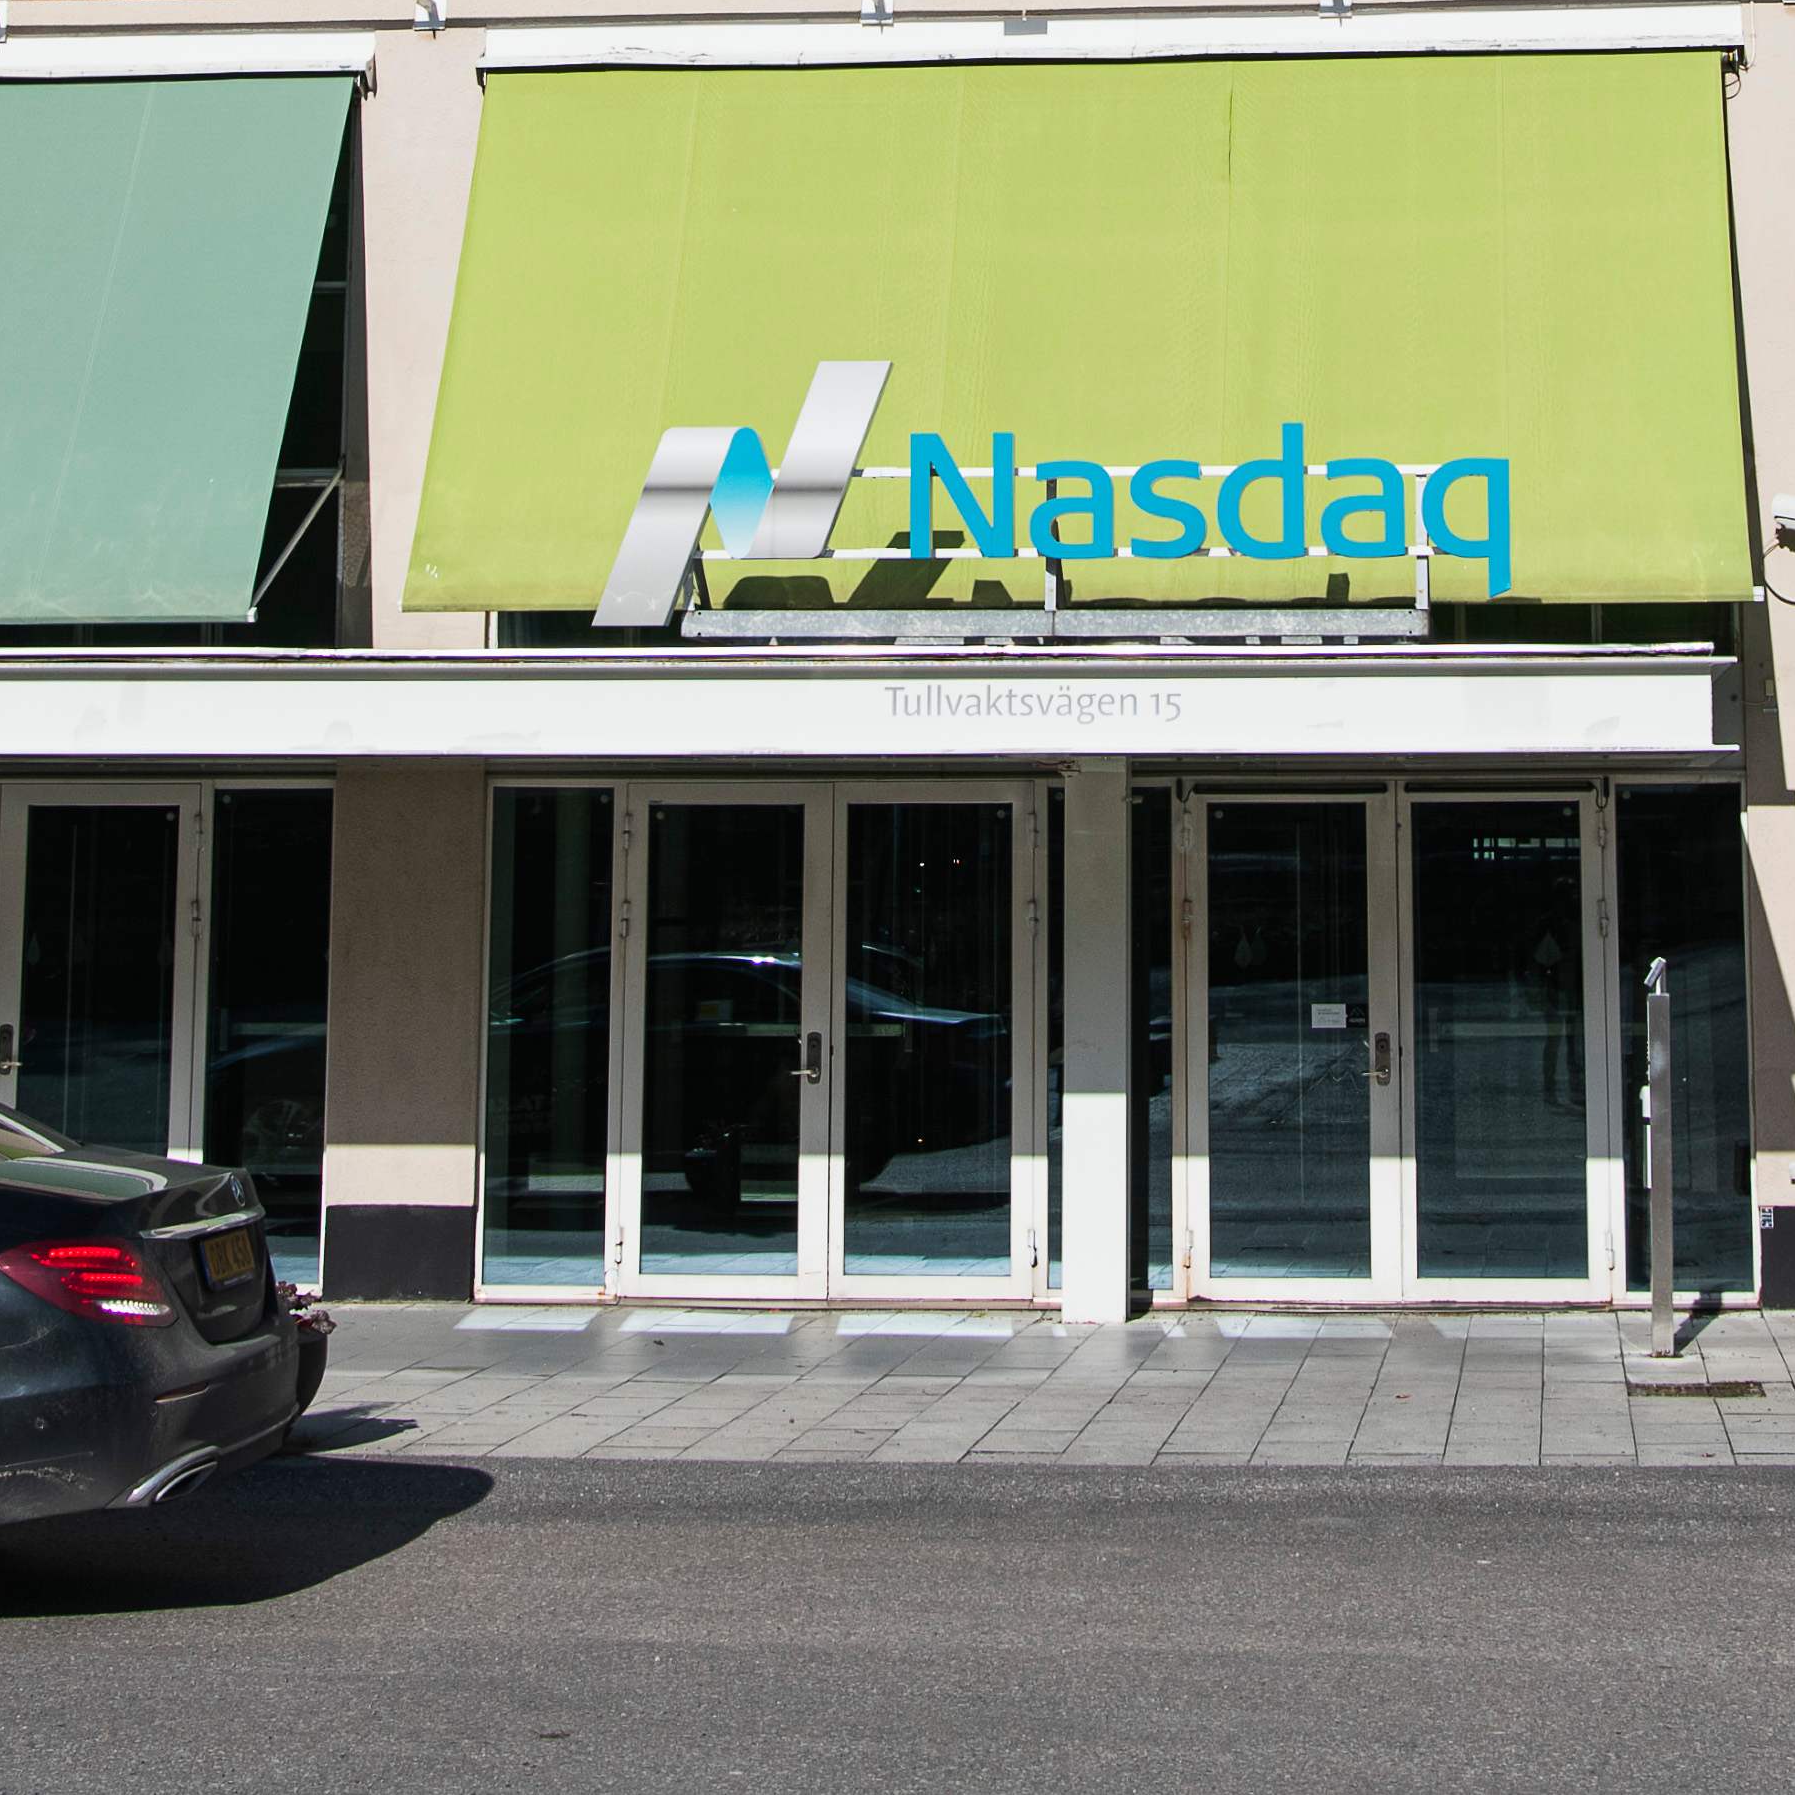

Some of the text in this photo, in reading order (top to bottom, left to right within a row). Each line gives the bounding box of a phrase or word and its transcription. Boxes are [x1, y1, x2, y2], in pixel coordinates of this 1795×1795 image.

[909, 423, 1512, 598] Nasdaq
[884, 684, 1182, 725] Tullvaktsvägen 15
